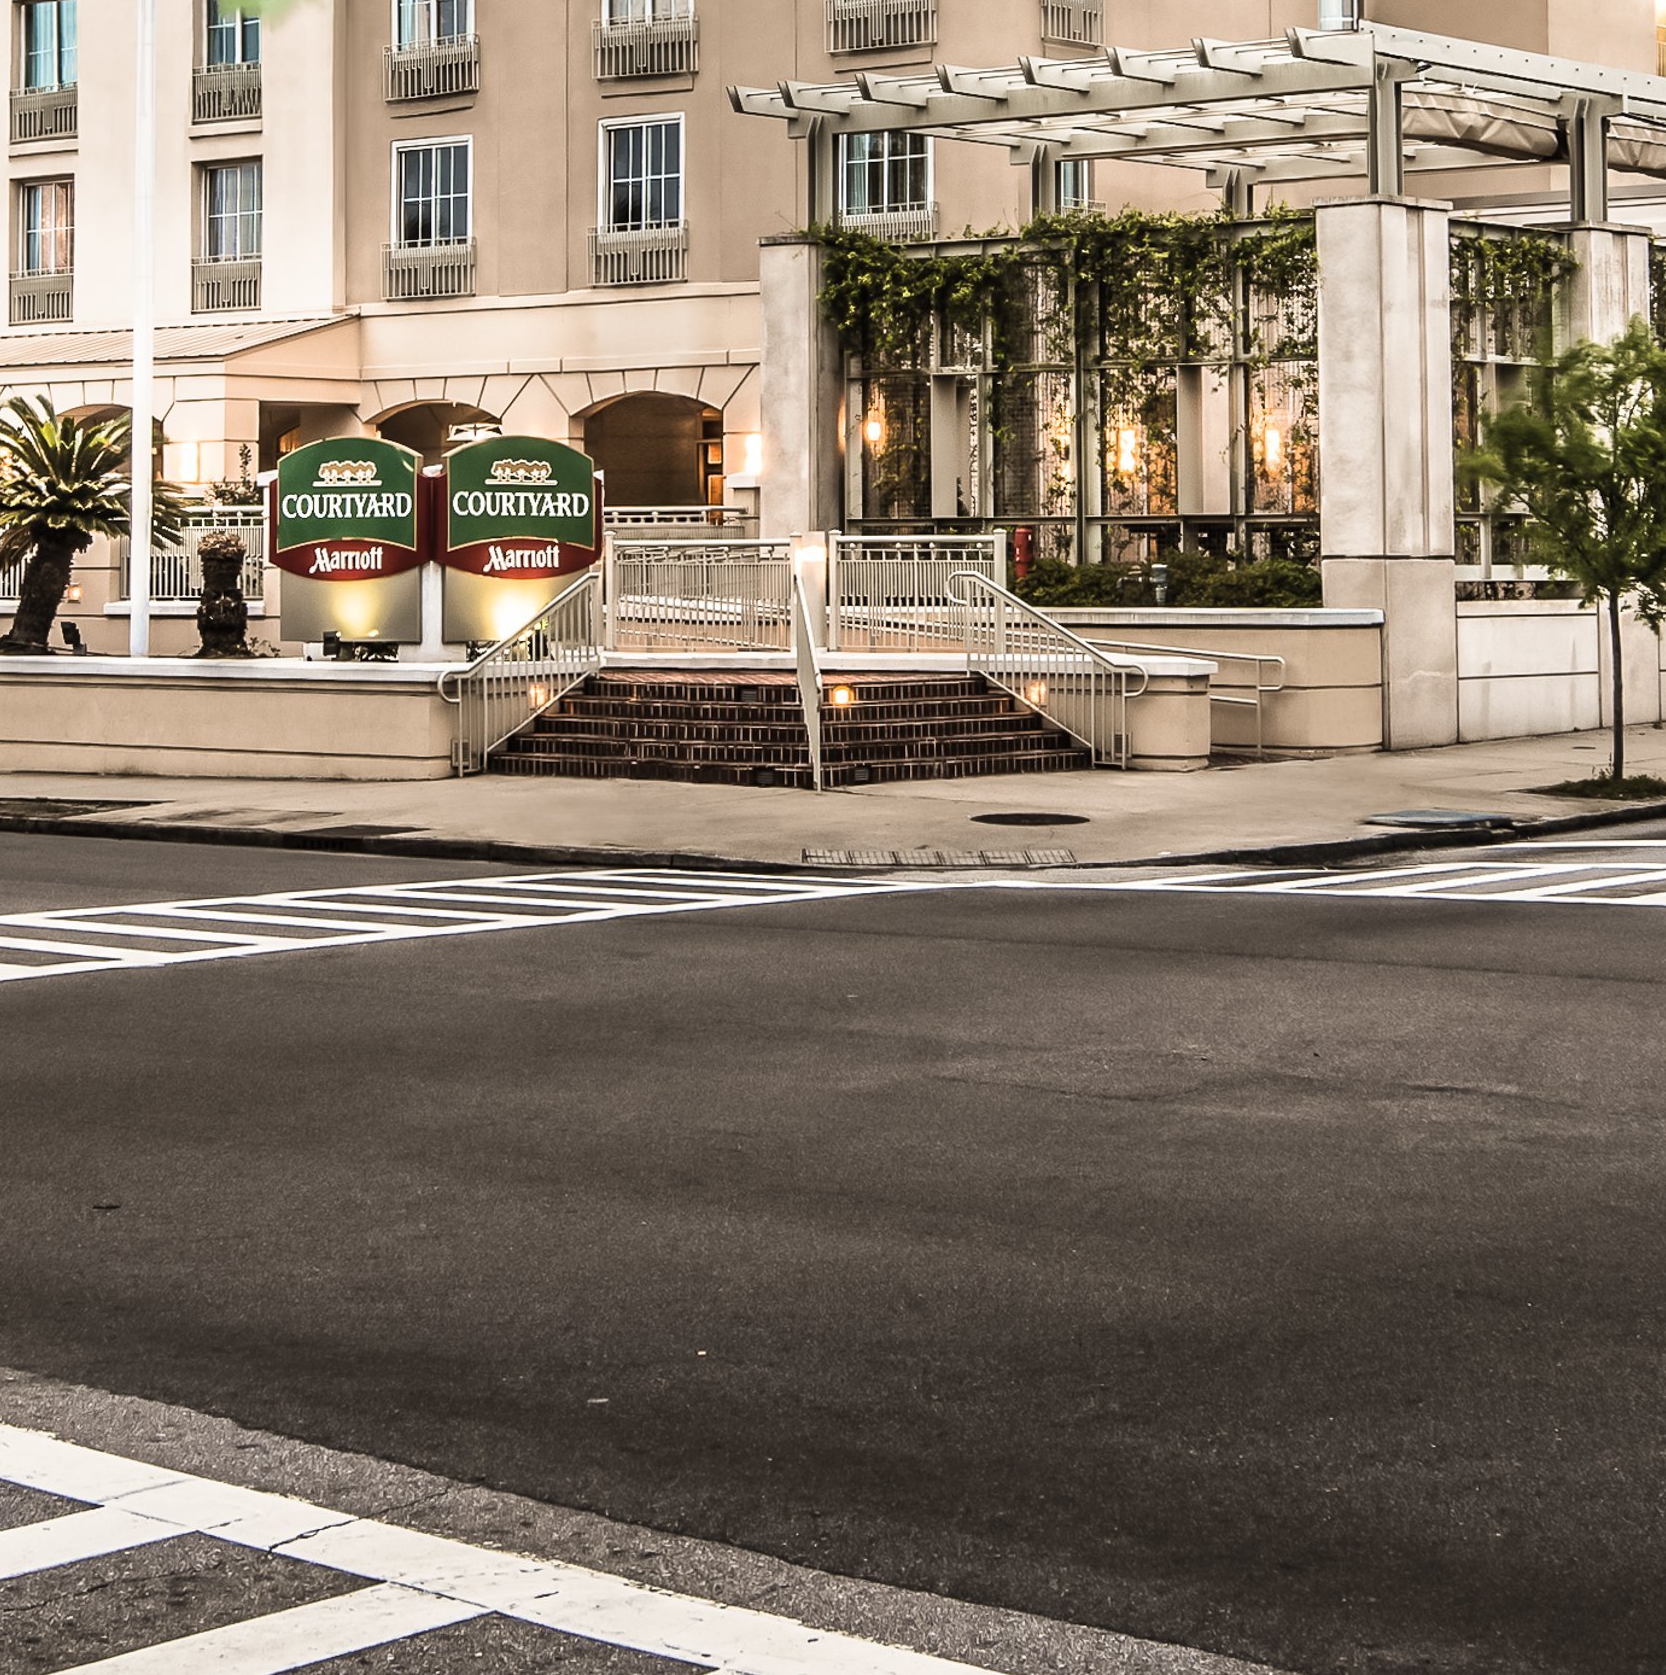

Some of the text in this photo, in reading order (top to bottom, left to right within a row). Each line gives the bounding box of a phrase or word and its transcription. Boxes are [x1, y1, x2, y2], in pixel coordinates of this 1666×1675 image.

[282, 493, 413, 519] COURTYARD
[452, 491, 590, 517] COURTYARD
[309, 547, 383, 574] Marriott
[483, 545, 560, 572] Marriott
